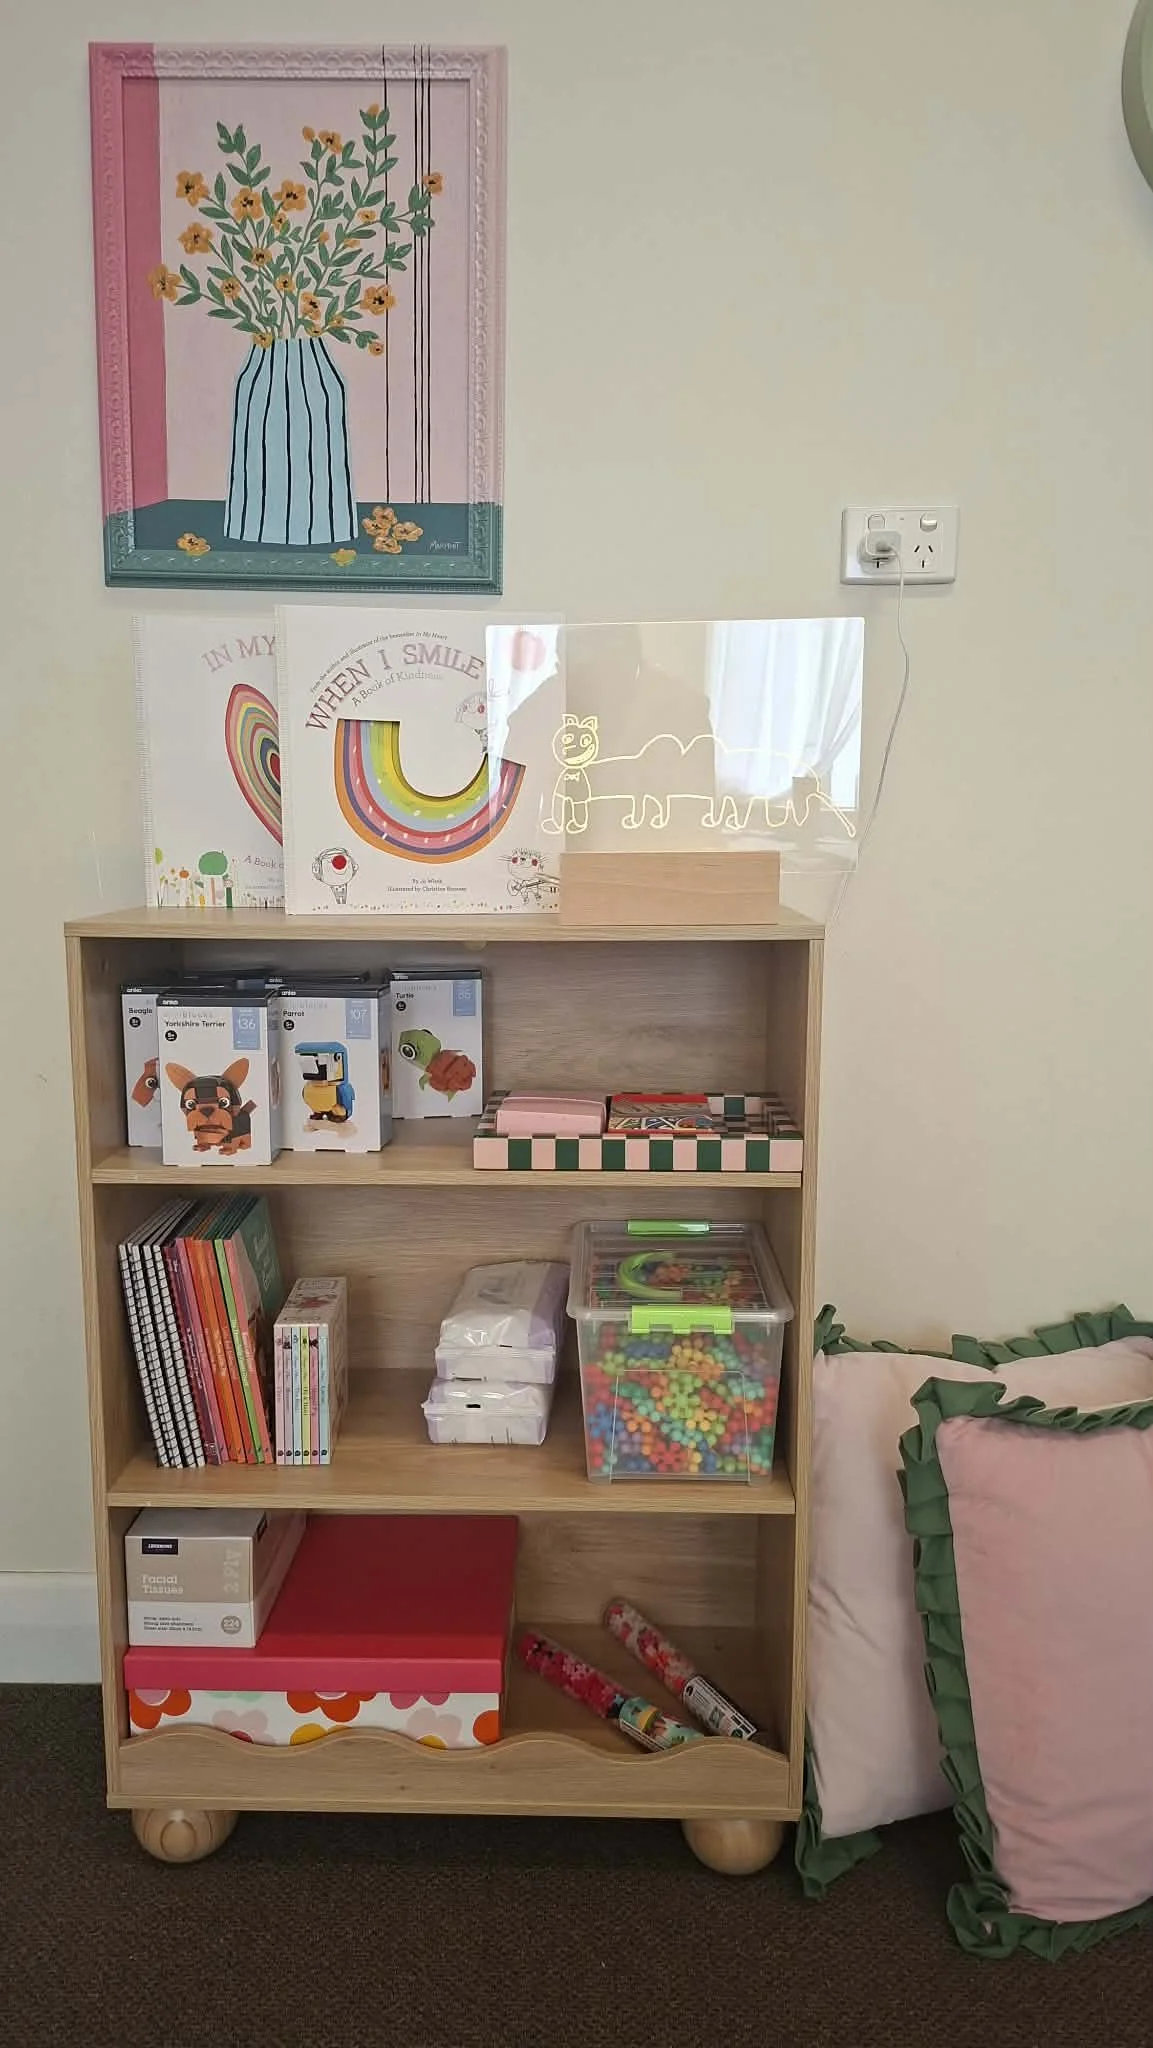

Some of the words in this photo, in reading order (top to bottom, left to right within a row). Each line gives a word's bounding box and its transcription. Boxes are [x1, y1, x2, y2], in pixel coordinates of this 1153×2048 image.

[200, 643, 233, 673] IN
[236, 635, 276, 658] MY
[305, 658, 371, 730] WHEN
[376, 649, 393, 670] I
[402, 642, 485, 680] SMILE
[351, 697, 361, 708] A
[360, 679, 384, 698] Book
[384, 671, 396, 687] of
[243, 855, 252, 865] A
[254, 856, 279, 870] Book
[396, 991, 415, 999] Turtle
[128, 1007, 153, 1016] Beagle
[282, 1009, 306, 1017] Parrot
[165, 1019, 200, 1028] Yorkshire
[201, 1019, 226, 1028] Terrier
[238, 1016, 256, 1031] 136
[142, 1574, 178, 1585] Facial
[142, 1585, 184, 1596] Tissues
